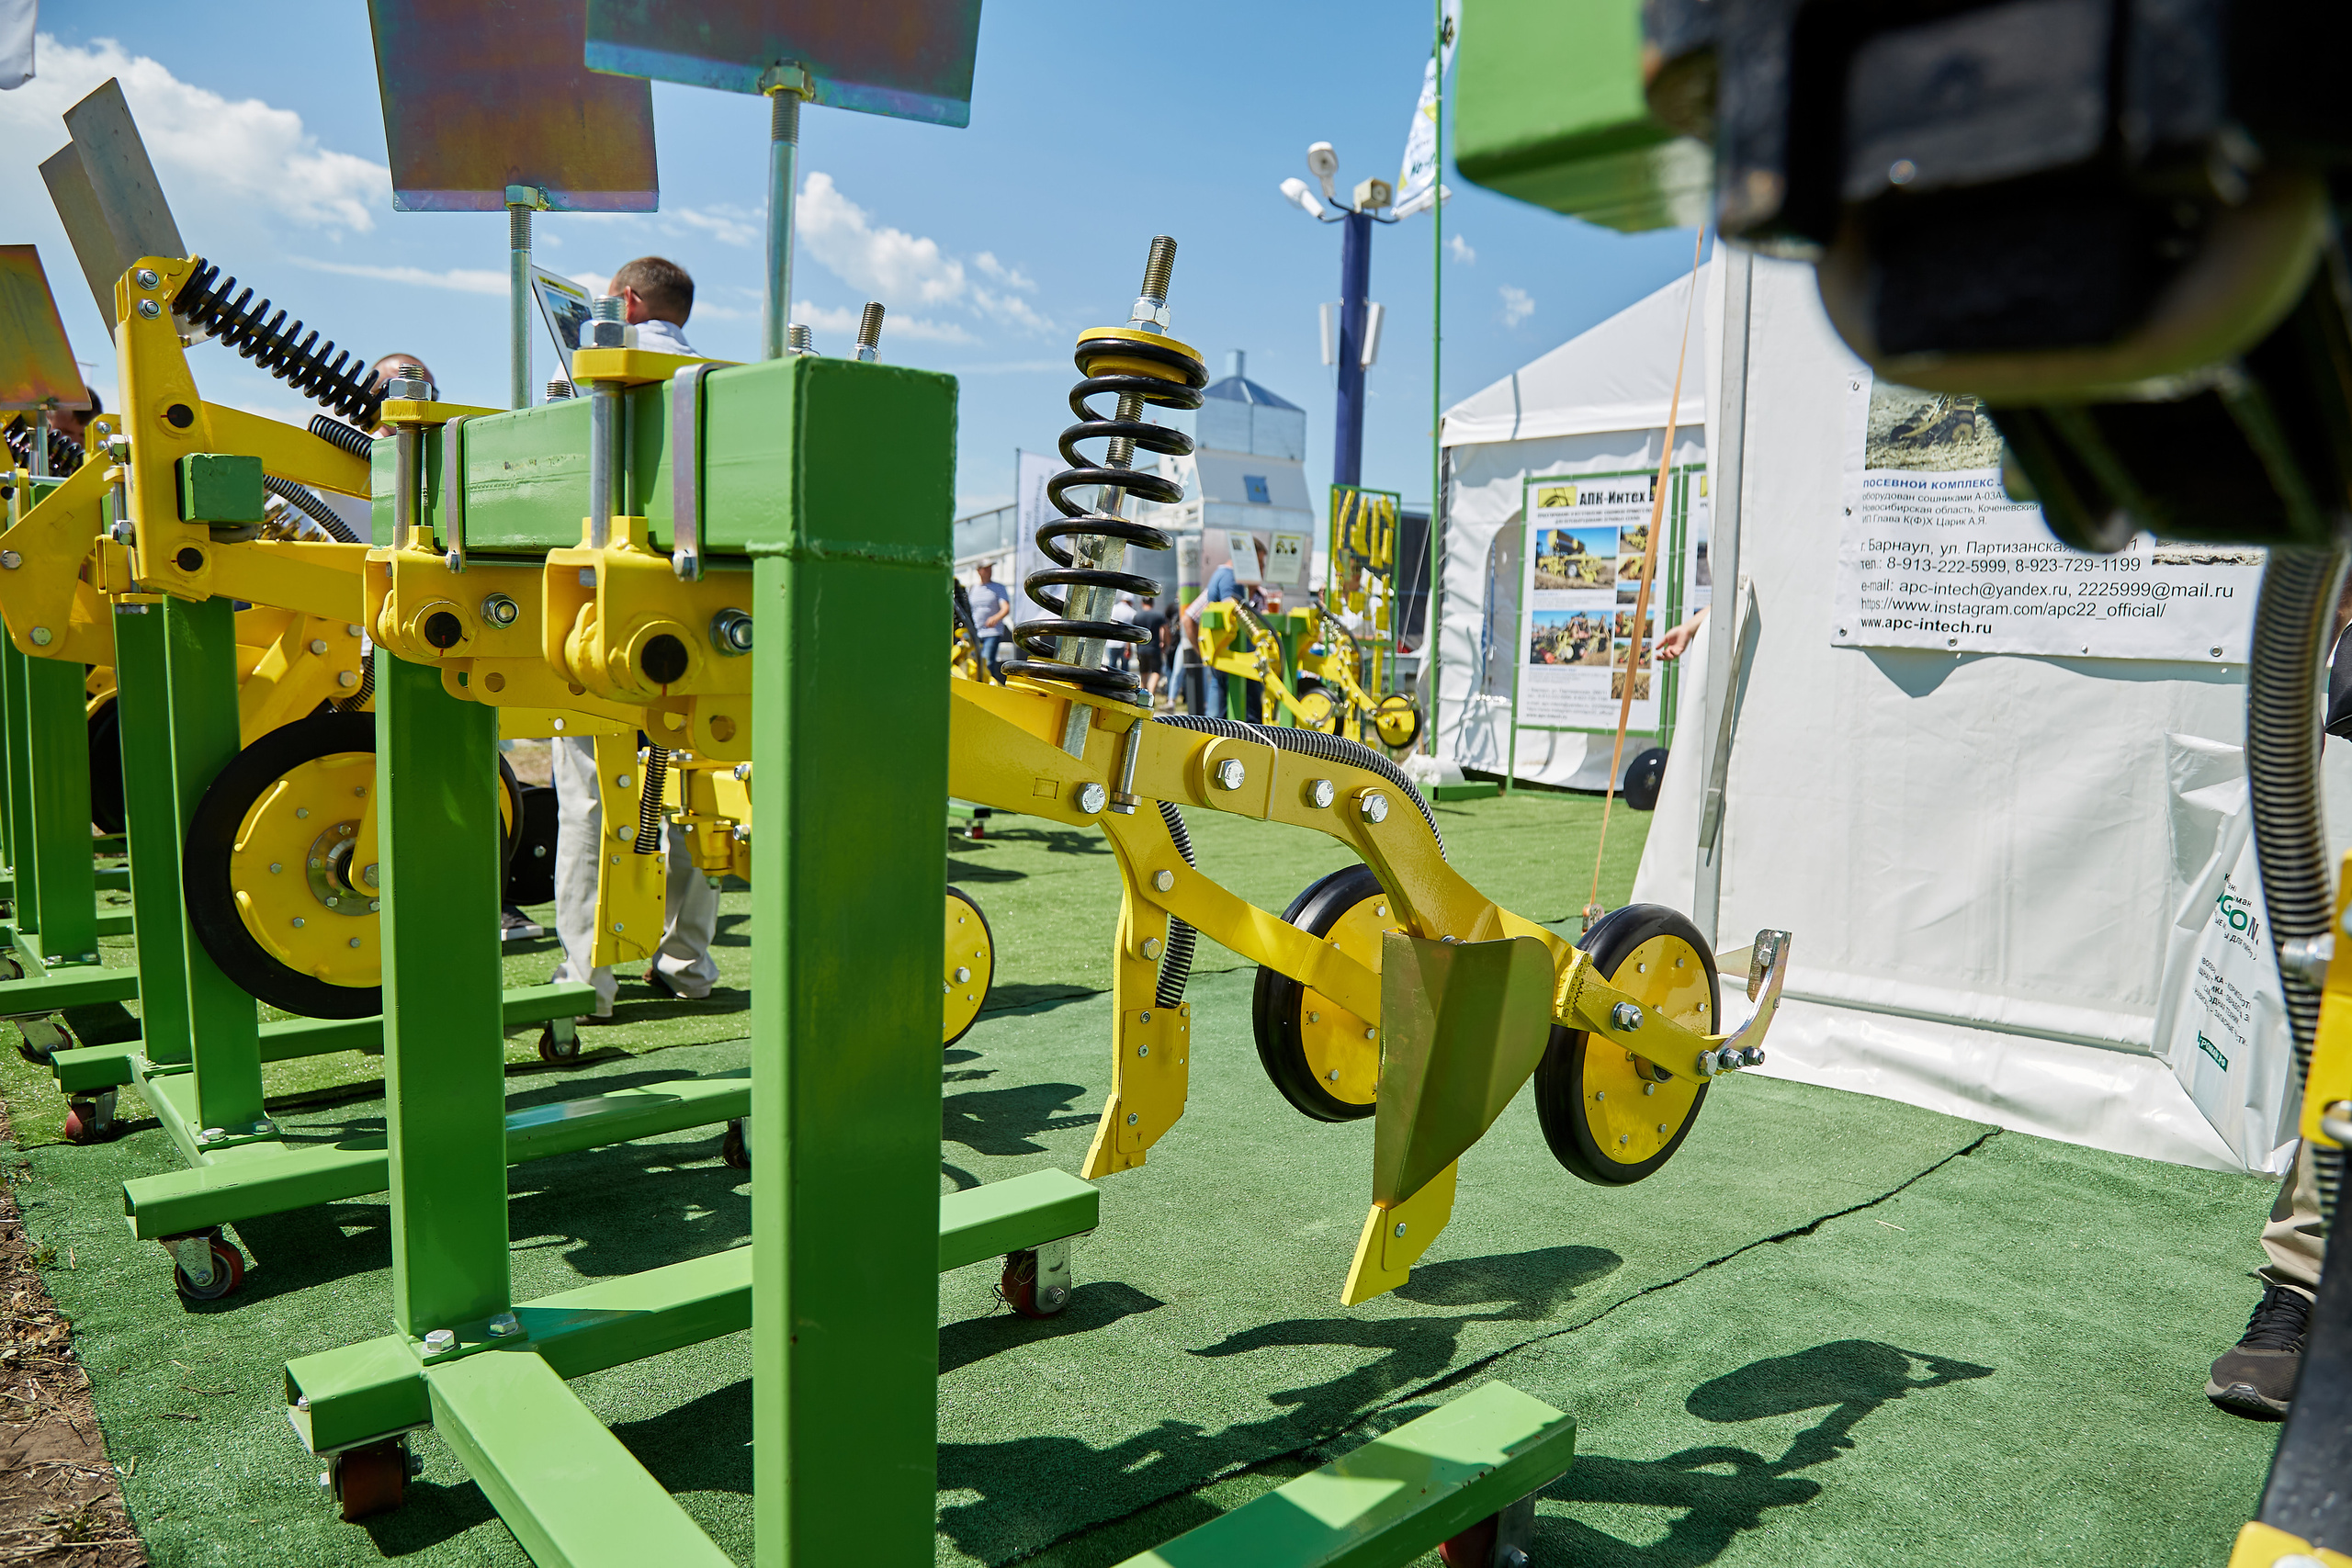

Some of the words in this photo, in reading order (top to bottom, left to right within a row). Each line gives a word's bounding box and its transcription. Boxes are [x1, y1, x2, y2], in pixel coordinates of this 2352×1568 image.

[1862, 479, 1928, 490] ПОСЕВНОЙ
[1931, 478, 1994, 490] КОМПЛЕКС
[1862, 491, 1915, 503] оборудован
[1917, 493, 1973, 502] сошниками
[1862, 504, 1932, 514] Новосибирская
[1935, 506, 1975, 514] область,
[1978, 502, 2039, 513] Коченевский
[1872, 515, 1900, 524] Глава
[1903, 515, 1933, 526] К(Ф)Х
[1937, 517, 1966, 527] Царик
[1968, 516, 1987, 525] А.Я.
[1869, 538, 1934, 555] Барнаул,
[1939, 544, 1962, 558] ул.
[1860, 559, 1882, 570] тел.:
[1886, 557, 2010, 574] 8-913-222-5999,
[2015, 557, 2141, 573] 8-923-729-1199
[1860, 579, 1894, 592] e-mail:
[1899, 581, 2073, 600] apc-intech@yandex.ru,
[2077, 581, 2234, 601] 2225999@mail.ru
[1861, 598, 2166, 620] https://www.instagram.com/apc22_official/
[1861, 617, 1992, 634] www.apc-intech.ru
